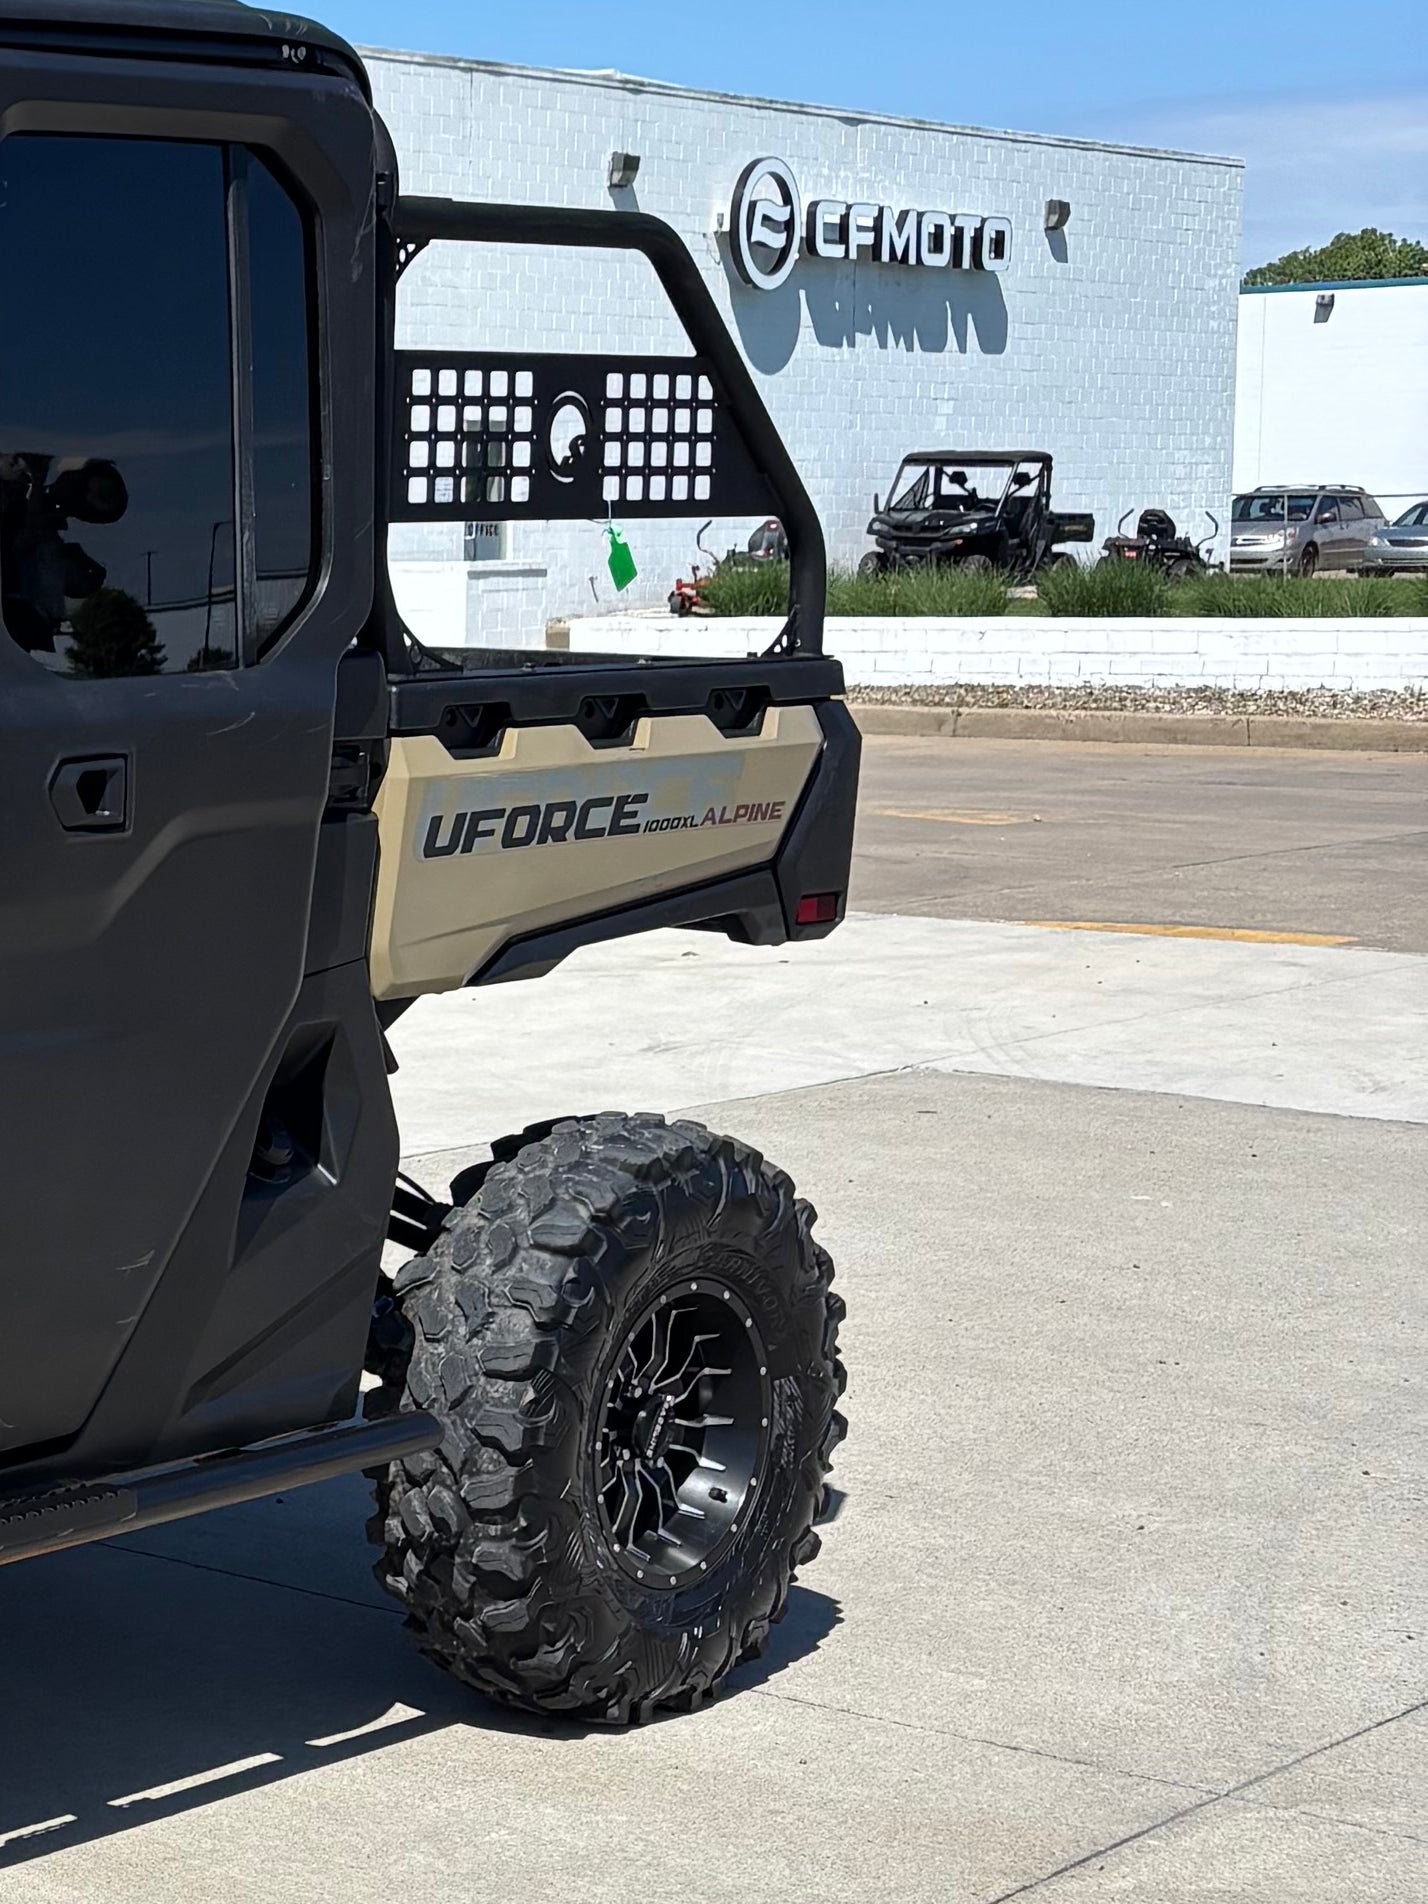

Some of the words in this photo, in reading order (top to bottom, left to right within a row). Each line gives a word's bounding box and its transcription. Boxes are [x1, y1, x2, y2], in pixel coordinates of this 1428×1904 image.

[807, 199, 1012, 272] CFMOTO
[423, 793, 649, 859] UFORCE
[643, 815, 699, 834] 1000XL
[700, 801, 786, 826] ALPINE
